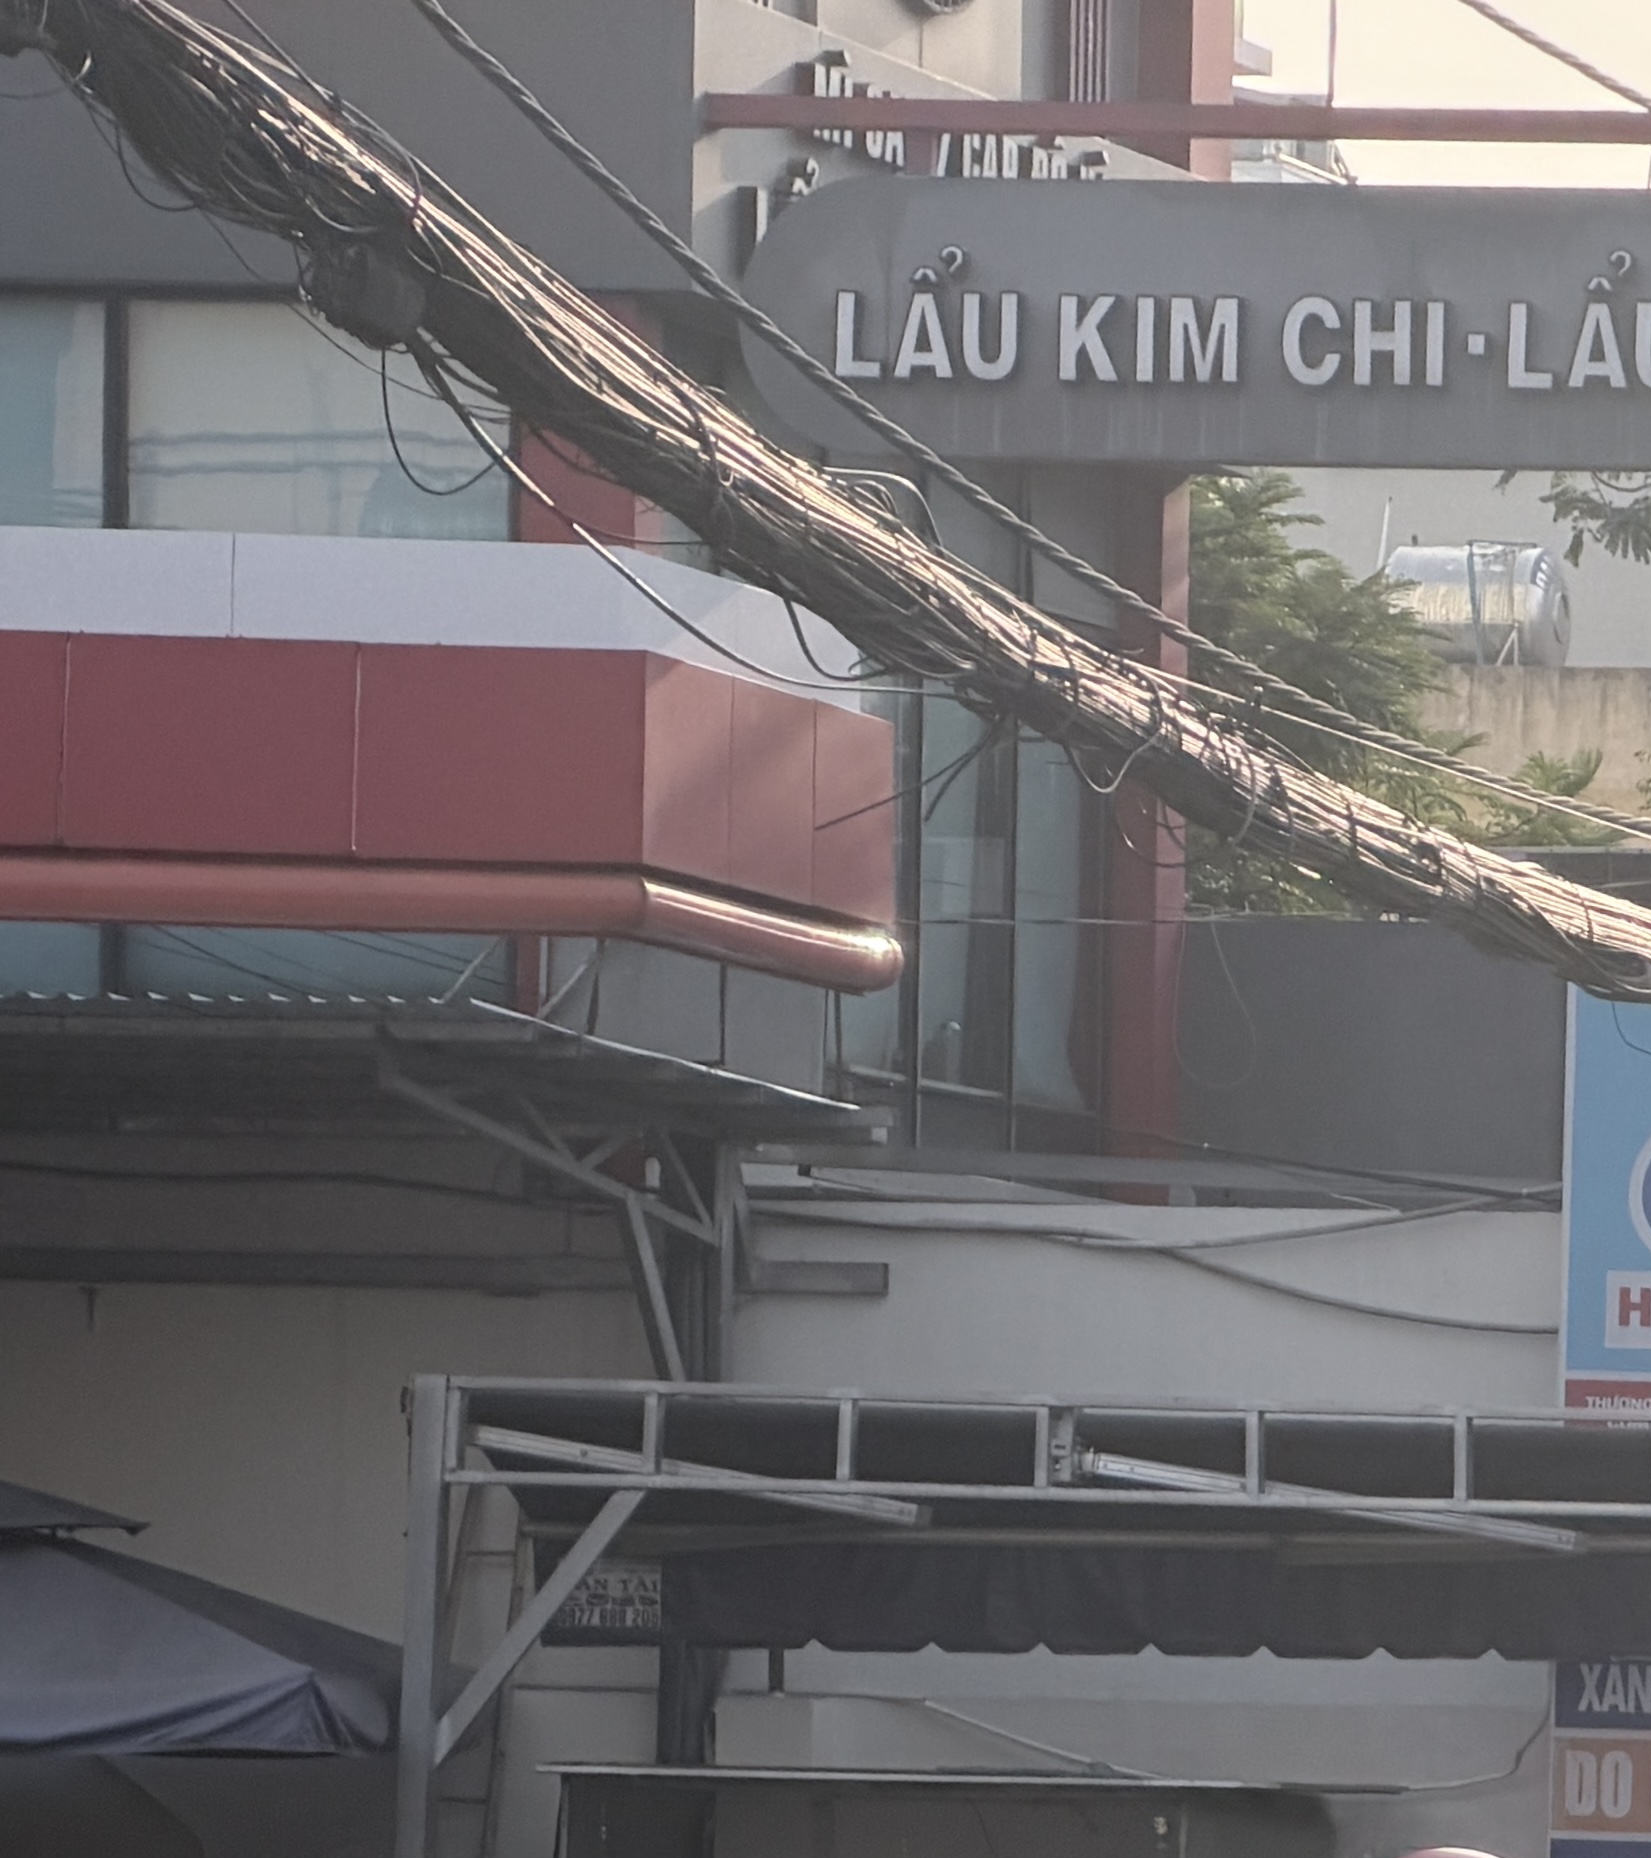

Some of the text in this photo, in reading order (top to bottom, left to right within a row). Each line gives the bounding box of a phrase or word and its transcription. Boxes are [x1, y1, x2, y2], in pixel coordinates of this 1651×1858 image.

[835, 245, 1018, 381] LẨU
[1057, 295, 1239, 383] KIM
[1563, 1750, 1633, 1819] DO
